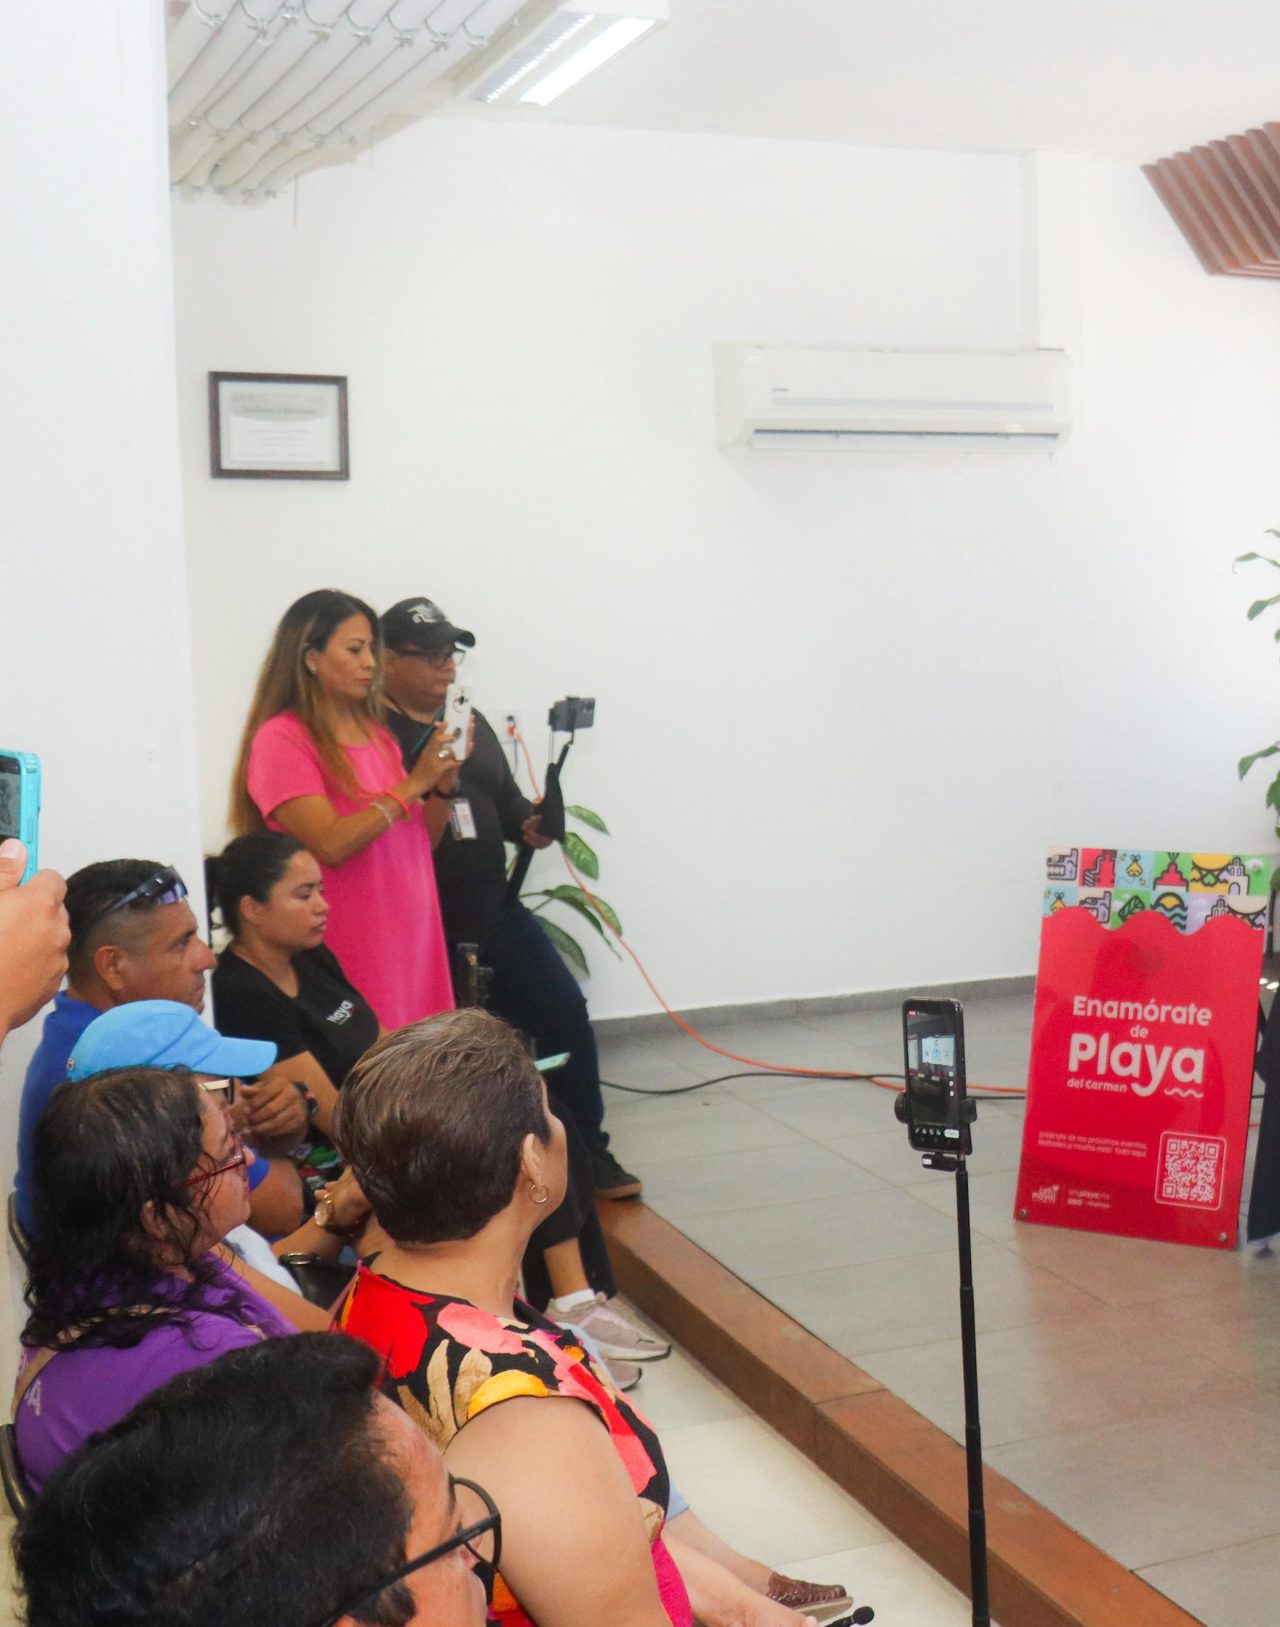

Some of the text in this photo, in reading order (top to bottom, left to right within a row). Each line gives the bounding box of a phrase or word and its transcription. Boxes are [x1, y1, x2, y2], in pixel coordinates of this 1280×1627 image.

[1073, 995, 1213, 1027] Enamórate
[1130, 1025, 1148, 1038] de
[1068, 1032, 1205, 1097] Playa
[1067, 1078, 1084, 1088] del
